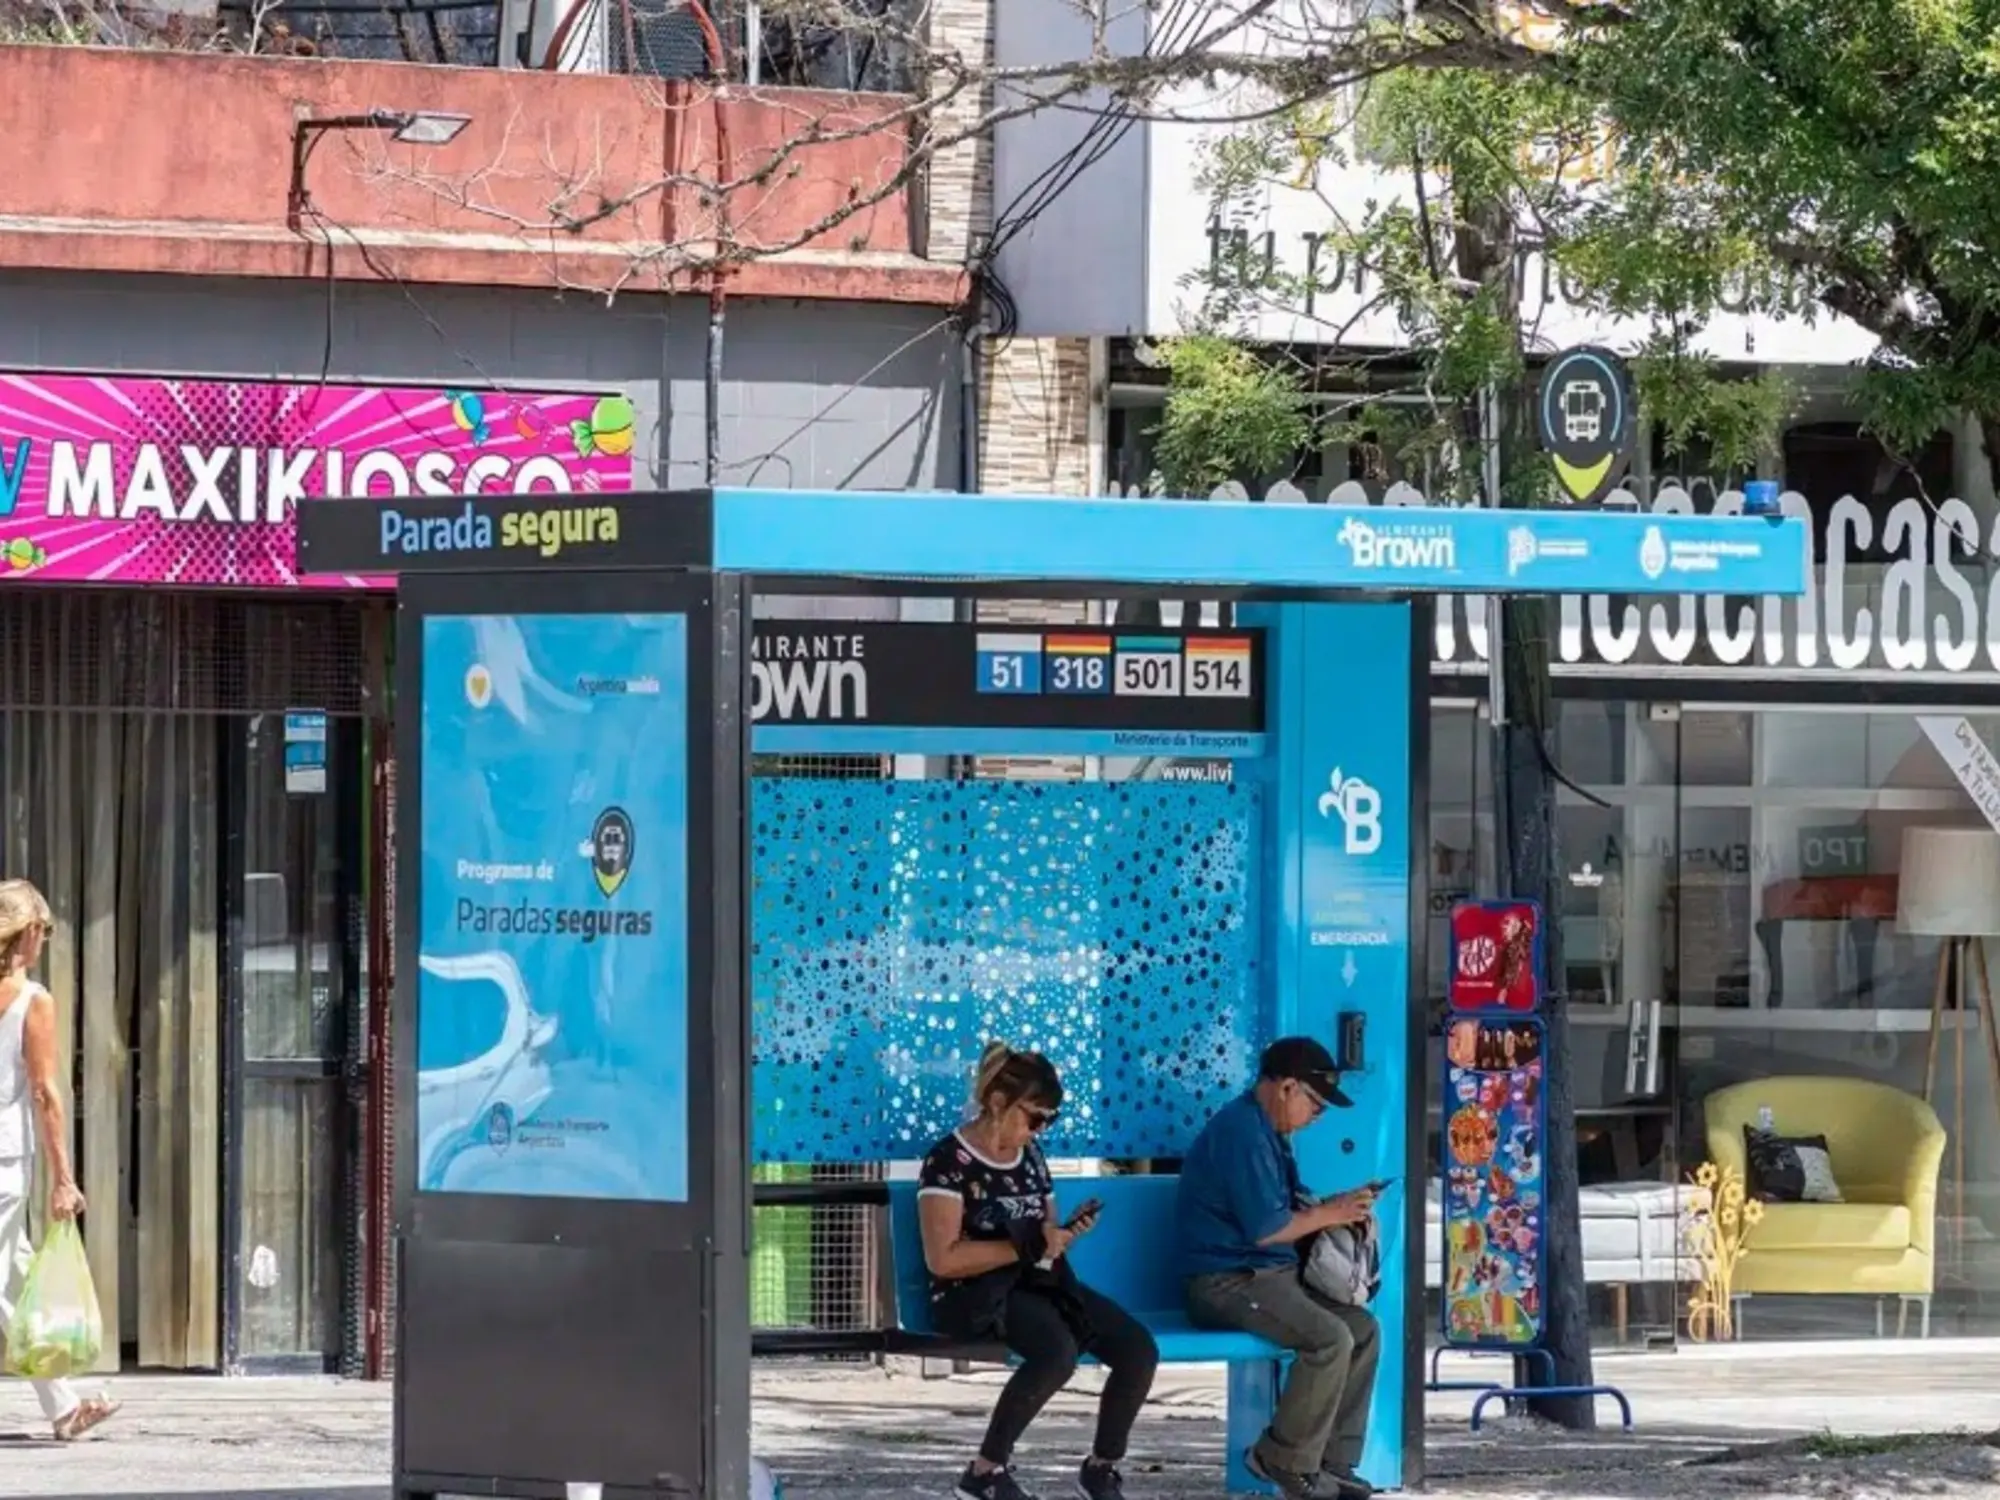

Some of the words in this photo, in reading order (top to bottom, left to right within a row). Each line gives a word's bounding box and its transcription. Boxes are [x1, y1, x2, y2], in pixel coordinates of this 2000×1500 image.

[380, 501, 492, 554] Parada
[502, 505, 619, 556] segura
[1352, 520, 1456, 568] Brown
[991, 655, 1023, 688] 51
[1053, 655, 1104, 690] 318
[1123, 658, 1173, 689] 501
[1193, 659, 1242, 691] 514
[1113, 732, 1172, 746] Ministerio
[1190, 734, 1248, 750] Transporte
[457, 859, 534, 884] Programa
[536, 857, 555, 880] de
[1310, 931, 1390, 945] EMERGENCIA
